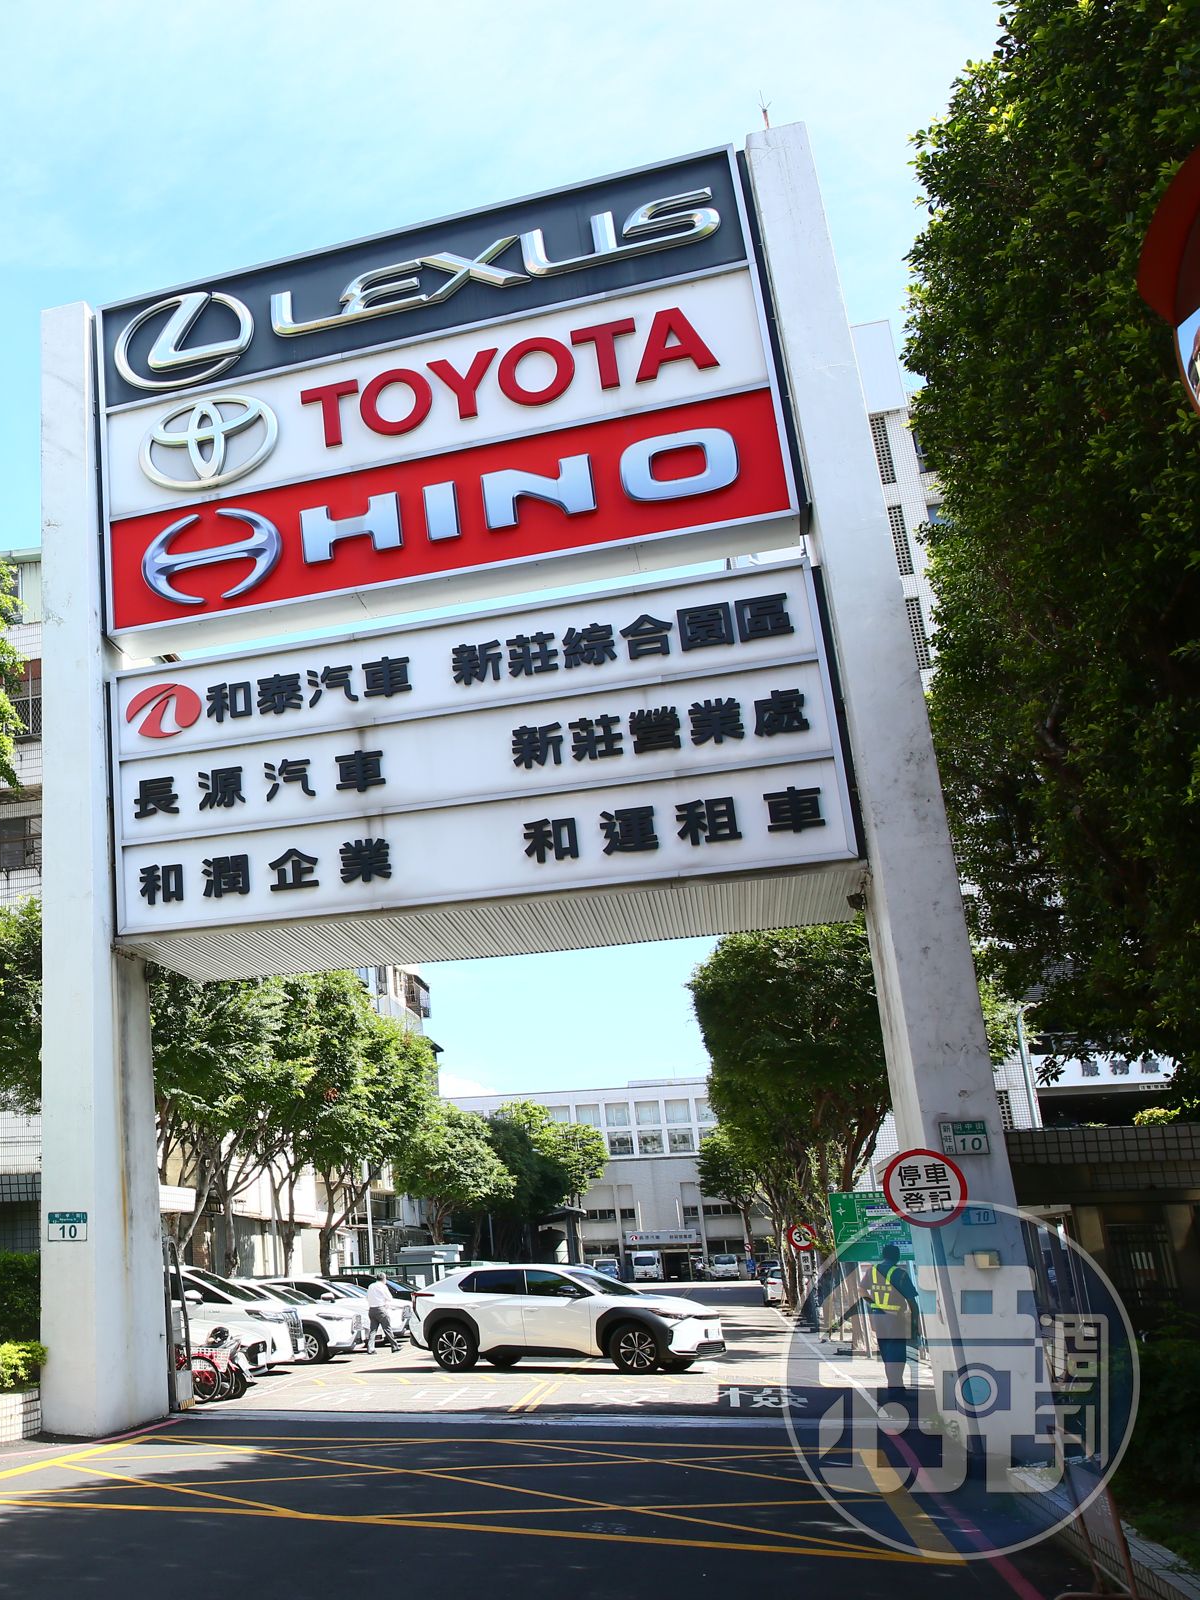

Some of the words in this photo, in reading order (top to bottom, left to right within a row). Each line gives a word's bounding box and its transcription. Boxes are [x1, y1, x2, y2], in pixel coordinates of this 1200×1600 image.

[270, 186, 722, 338] LEXUS
[300, 306, 720, 448] TOYOTA
[300, 427, 740, 564] HINO
[206, 655, 412, 724] 和泰汽車
[452, 592, 795, 687] 新莊綜合園區
[133, 749, 388, 820] 長源汽車
[511, 688, 811, 770] 新莊營業處
[139, 838, 393, 905] 和潤企業
[523, 786, 826, 864] 和運租車
[897, 1162, 949, 1187] 停車
[902, 1188, 954, 1213] 登記
[960, 1137, 982, 1152] 10
[59, 1225, 77, 1239] 10
